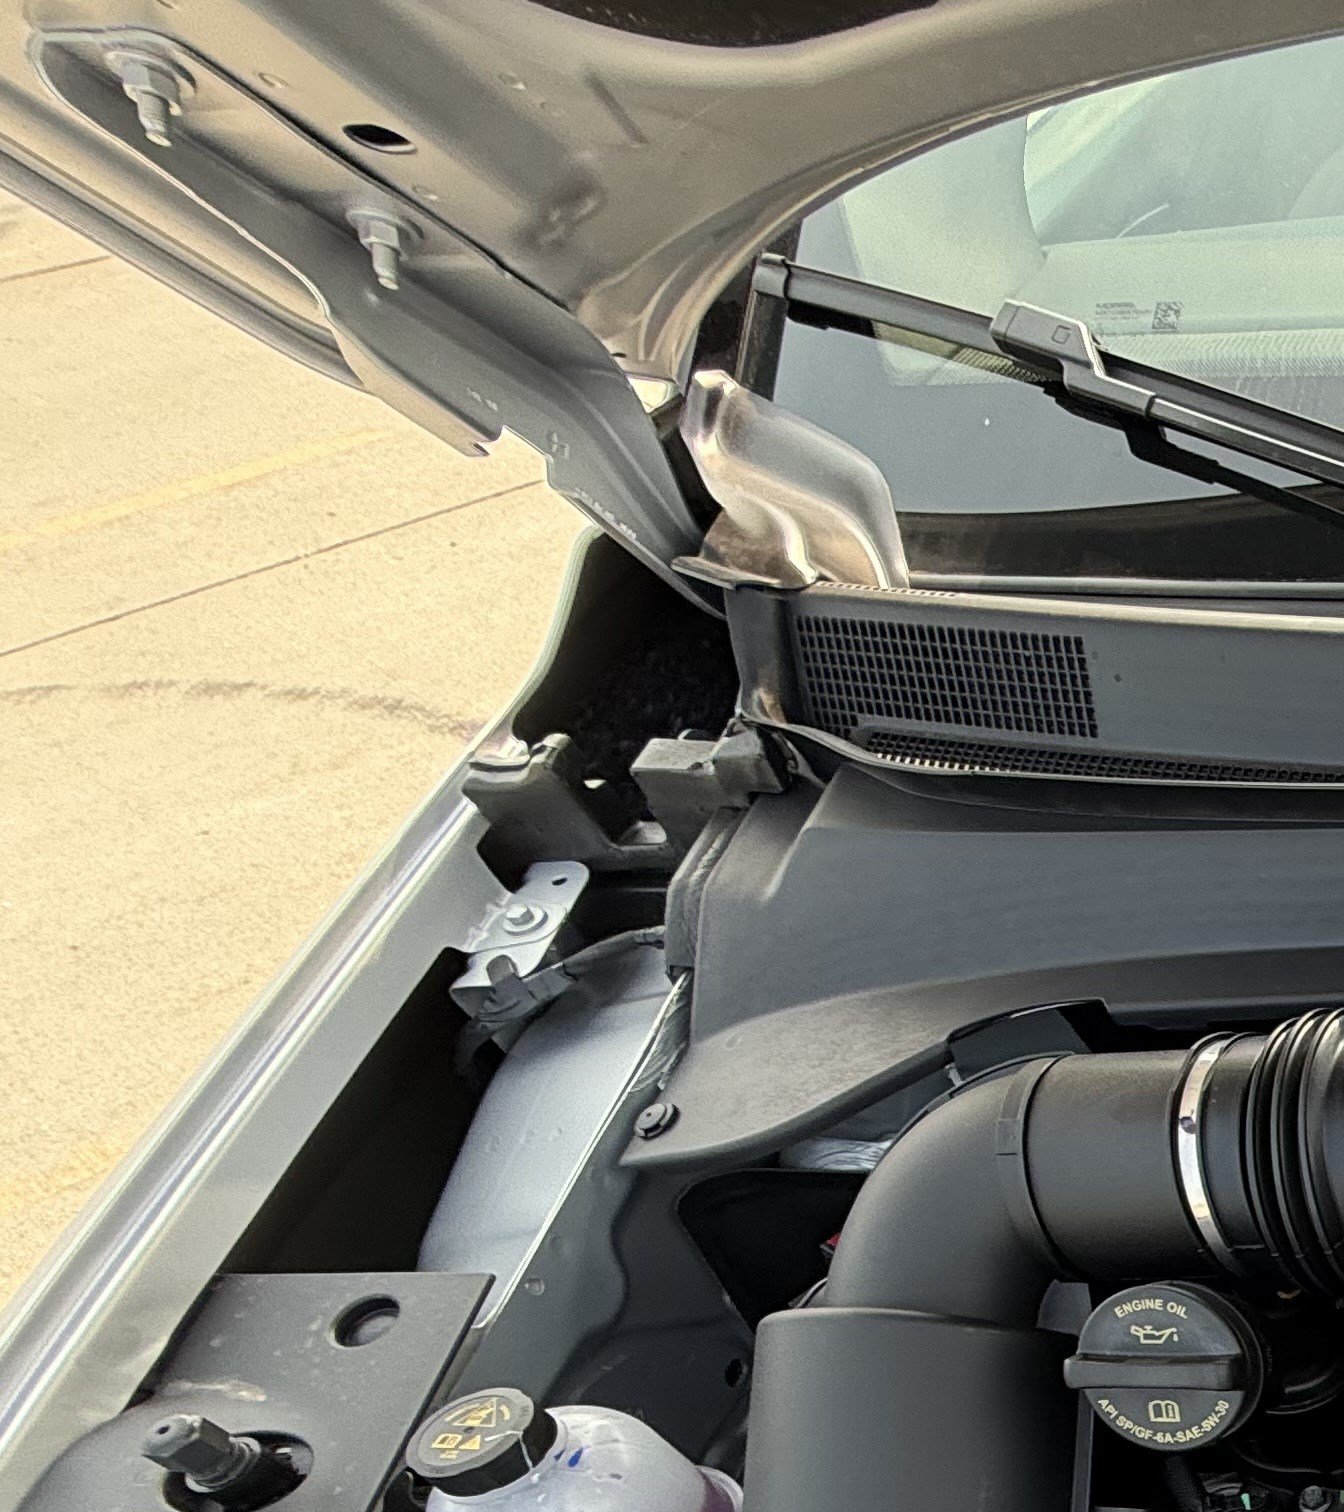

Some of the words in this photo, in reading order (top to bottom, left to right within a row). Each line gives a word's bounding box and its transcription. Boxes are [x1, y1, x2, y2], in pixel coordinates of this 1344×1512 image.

[1114, 1299, 1164, 1318] ENGINE
[1166, 1300, 1188, 1319] OIL
[1098, 1398, 1119, 1420] API
